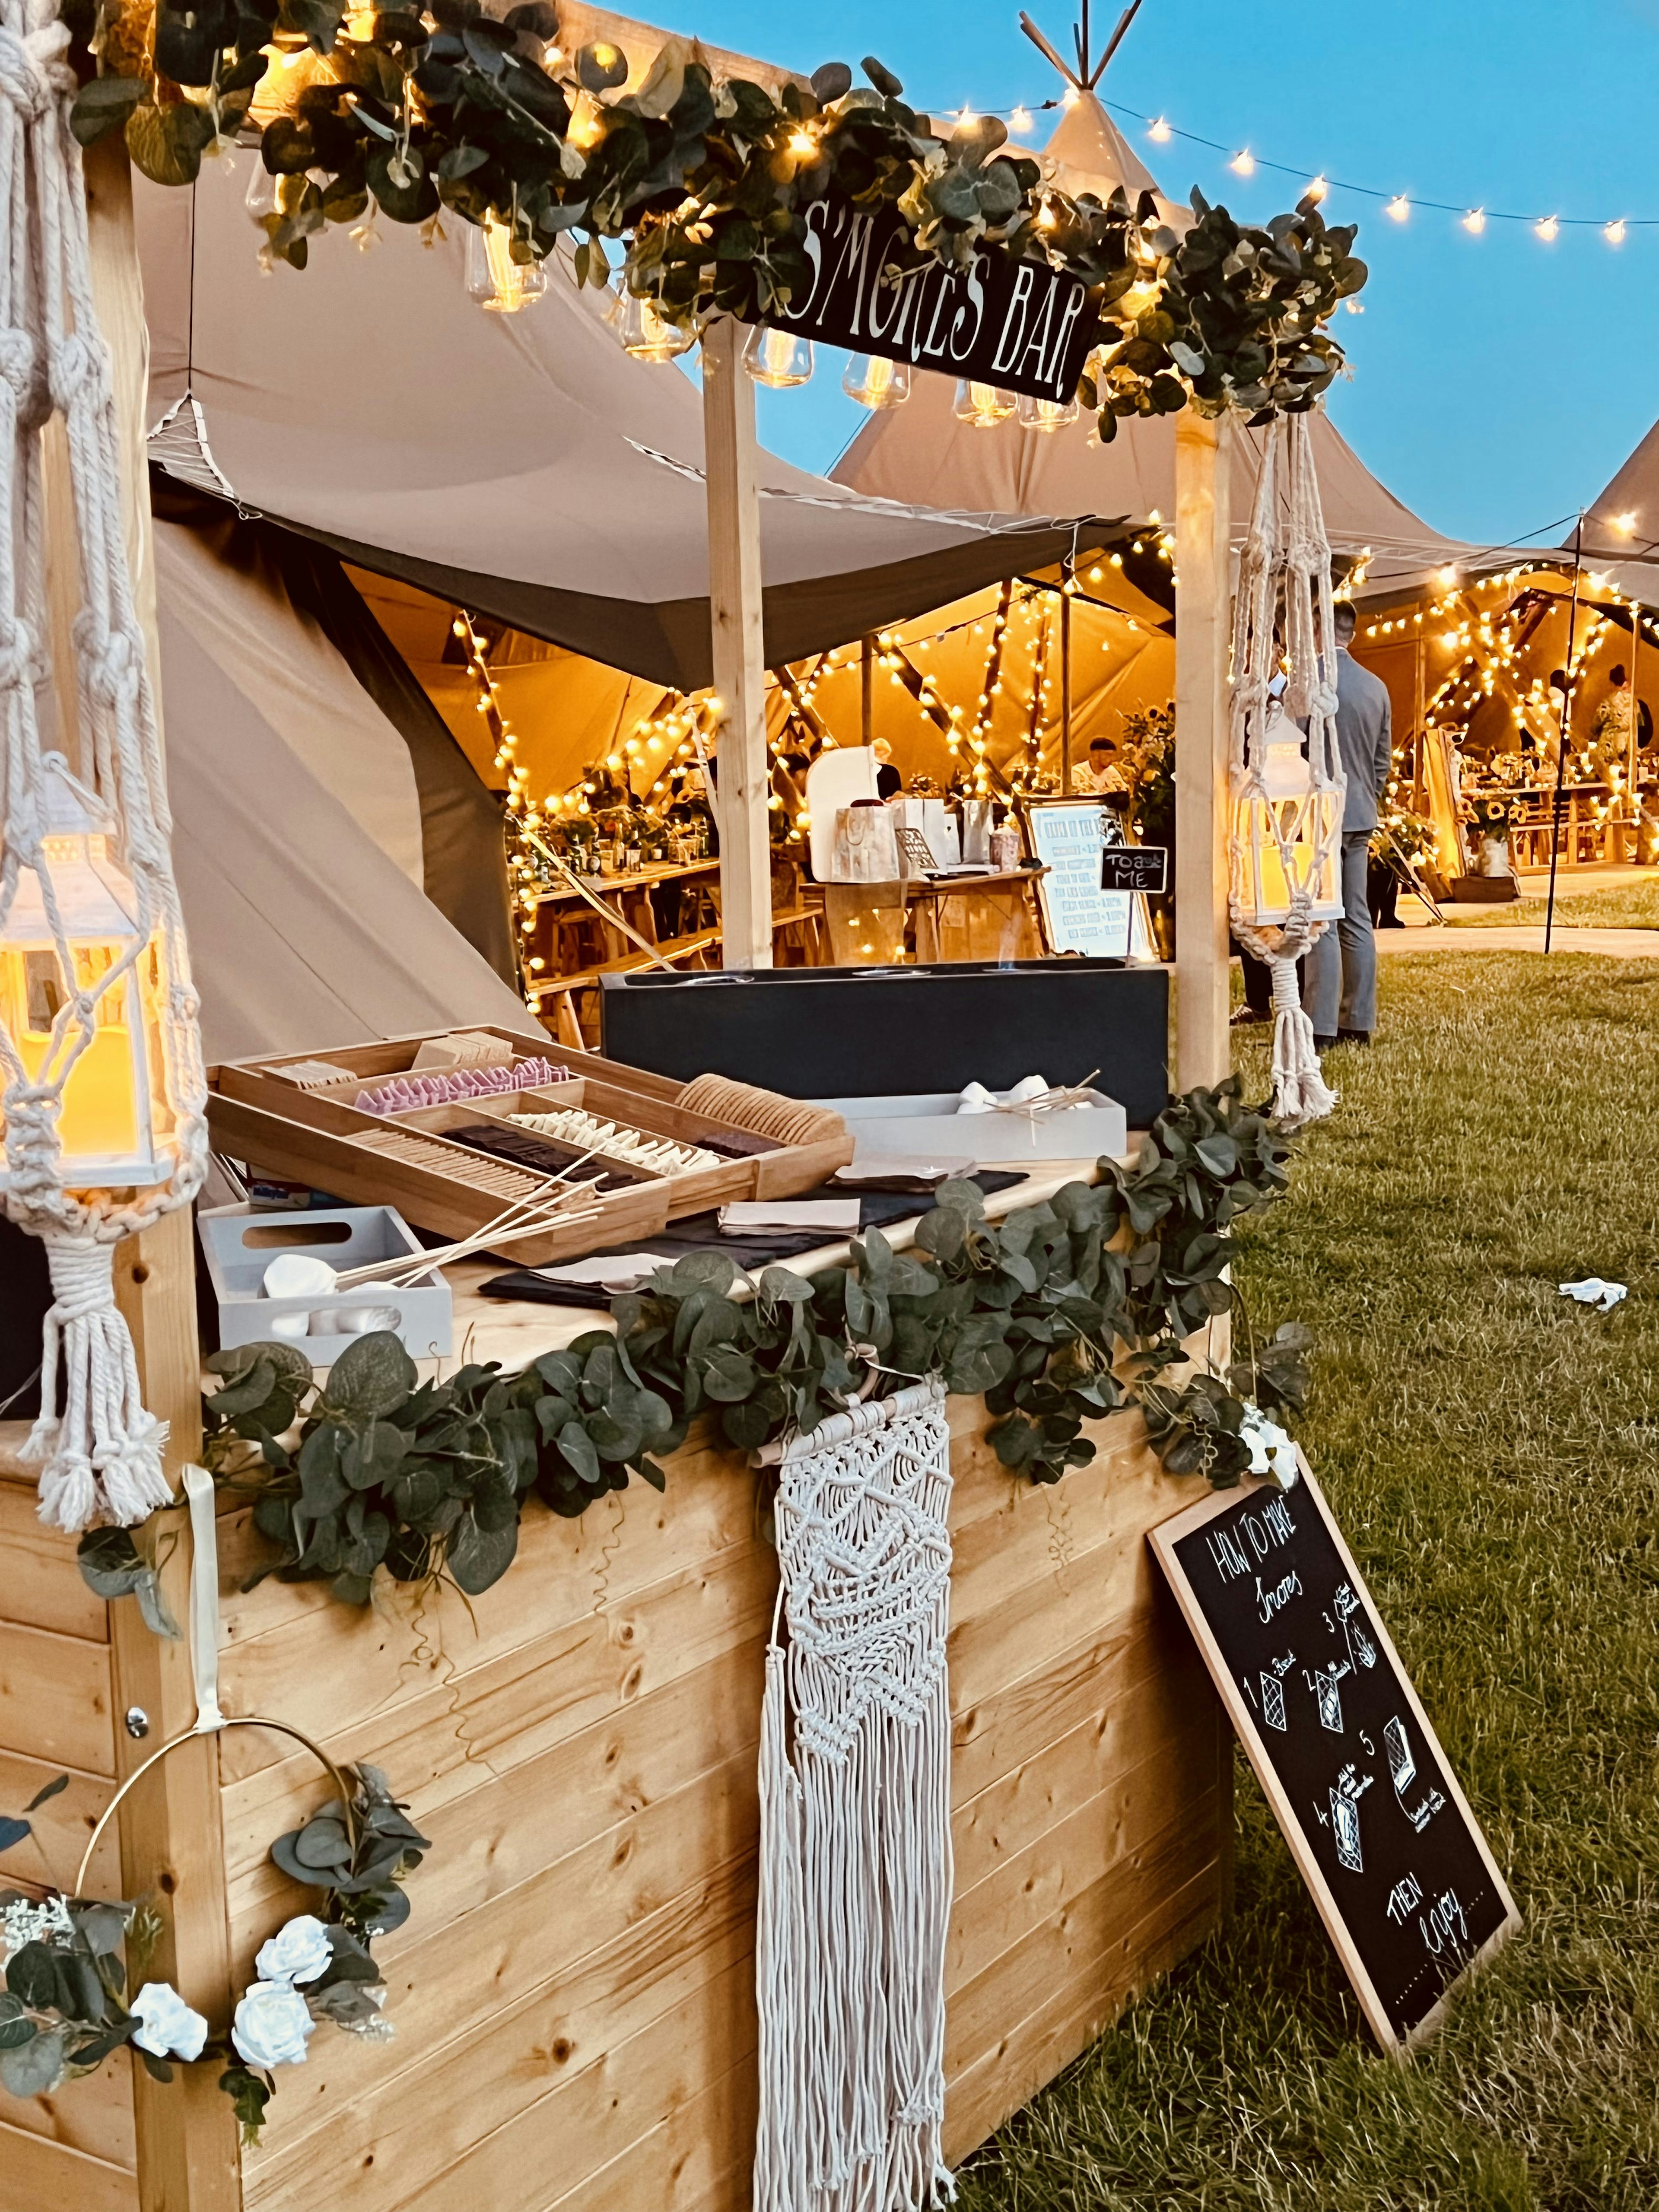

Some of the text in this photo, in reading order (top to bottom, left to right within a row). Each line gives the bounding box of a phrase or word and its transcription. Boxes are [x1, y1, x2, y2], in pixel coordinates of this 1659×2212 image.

[991, 265, 1085, 399] BAR
[1116, 870, 1149, 888] ME
[1205, 1494, 1297, 1584] HOW TO MAKE
[1322, 1611, 1335, 1633] 3
[1243, 1676, 1258, 1709] 1
[1302, 1669, 1316, 1692] 2
[1359, 1729, 1375, 1756] 5
[1312, 1800, 1329, 1828] 4
[1387, 1872, 1424, 1926] THEN
[1419, 1887, 1468, 1954] enjoy
